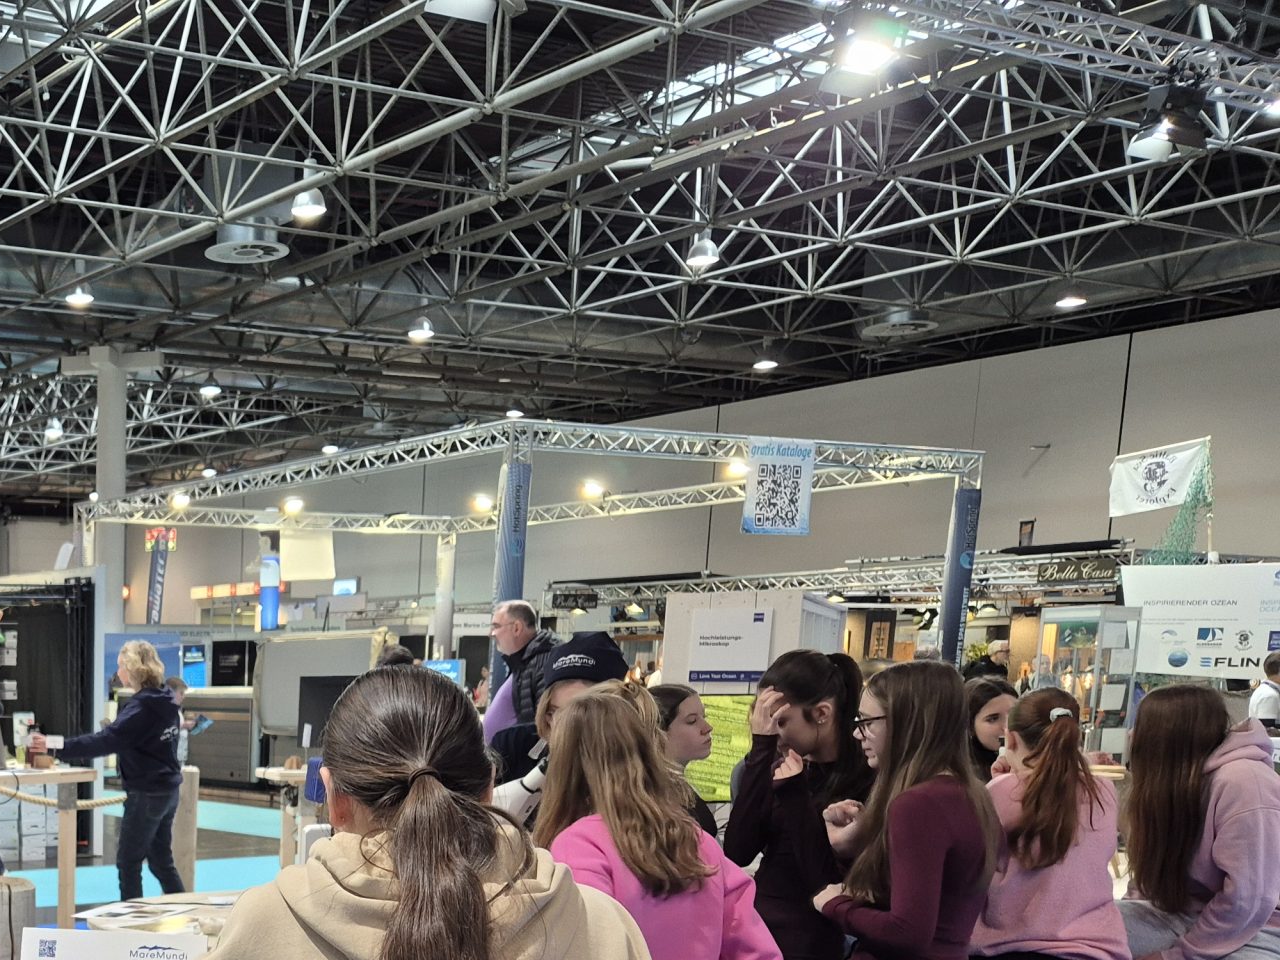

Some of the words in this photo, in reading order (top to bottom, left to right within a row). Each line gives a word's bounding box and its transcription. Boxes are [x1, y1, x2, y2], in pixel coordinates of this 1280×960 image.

[751, 443, 774, 457] gratis
[776, 444, 812, 460] Kataloge
[1039, 564, 1078, 580] Bella
[1081, 561, 1113, 578] Casa
[129, 949, 188, 960] MareMundi
